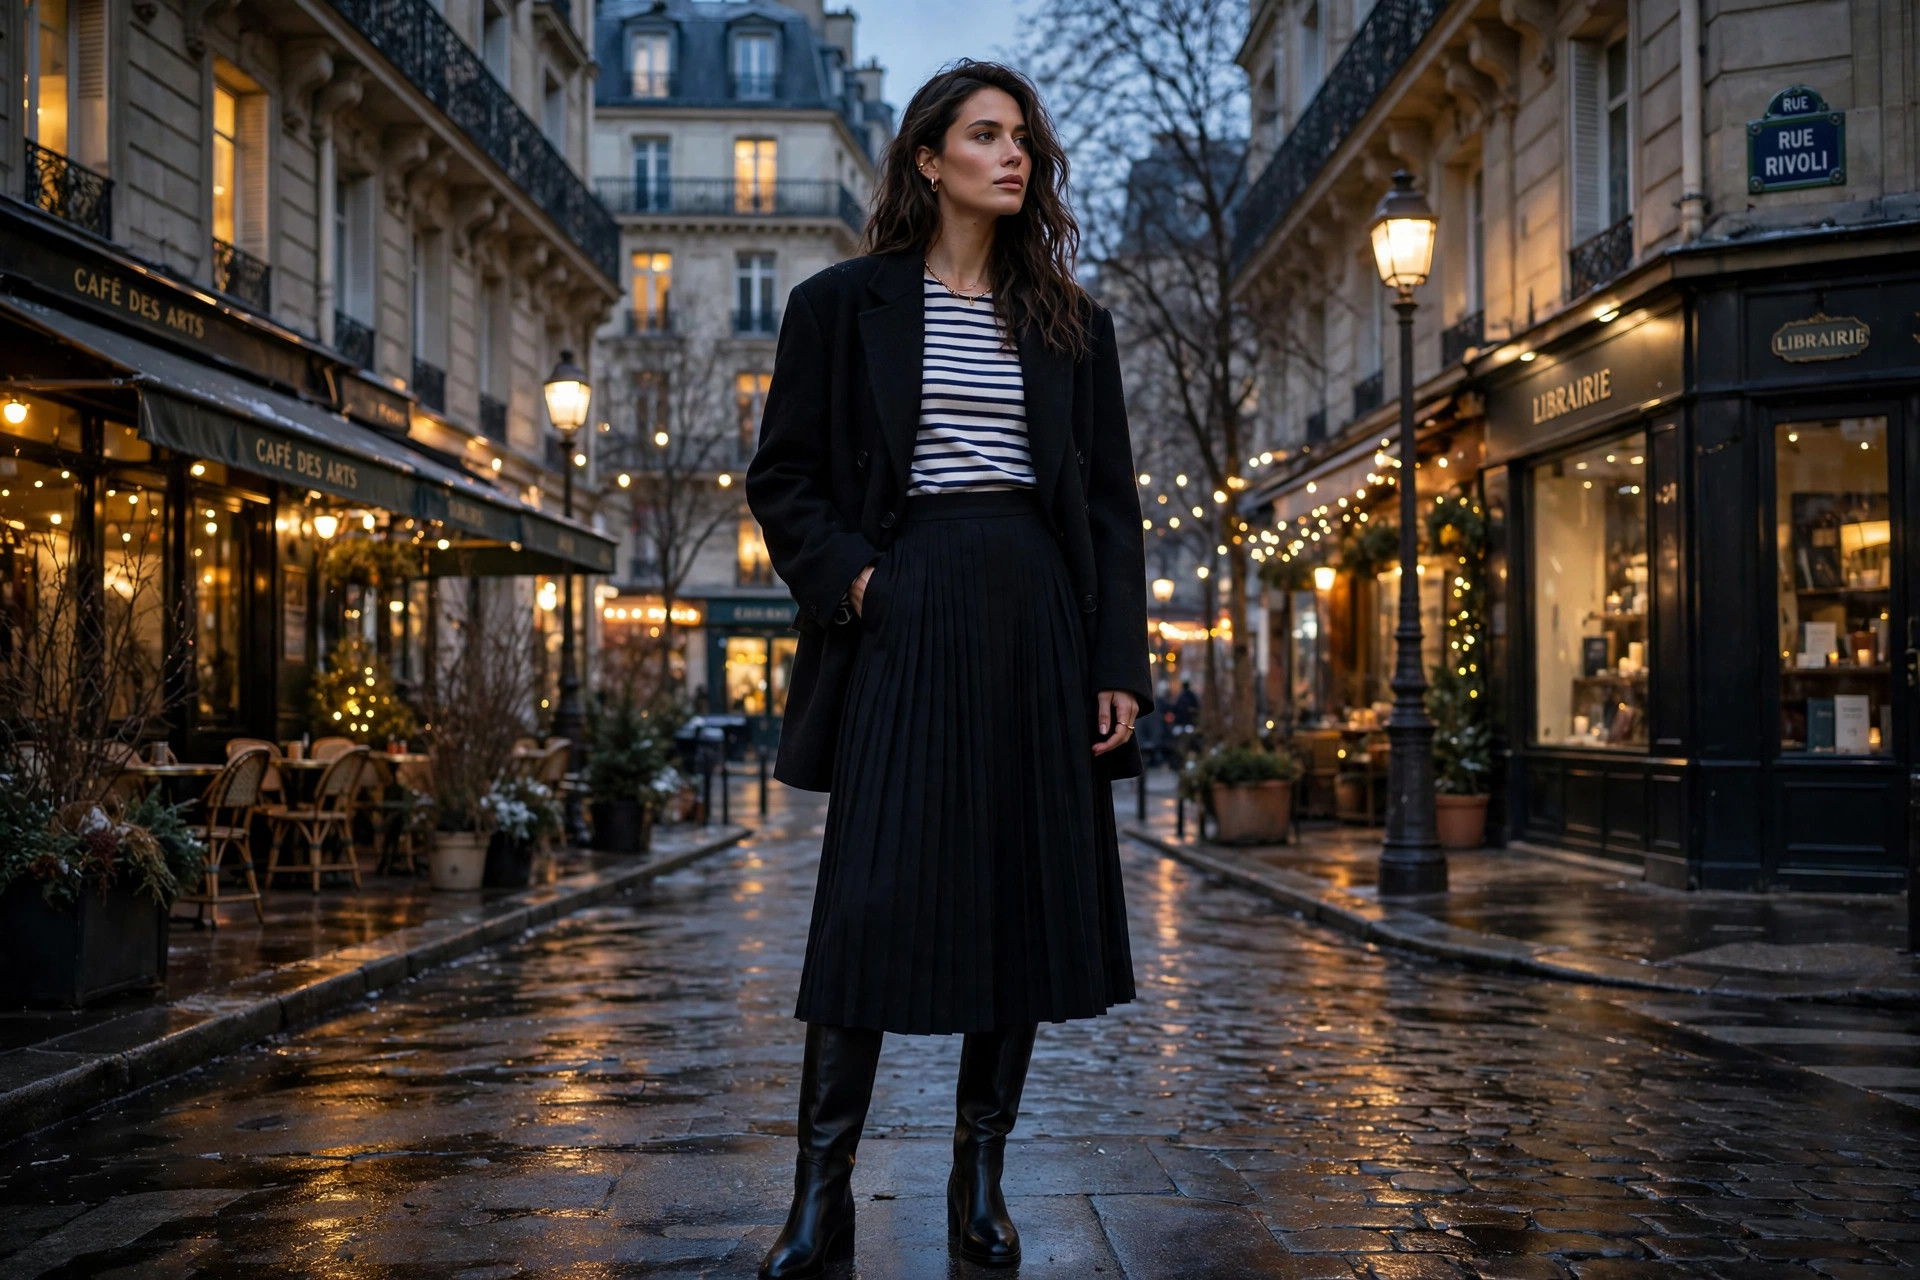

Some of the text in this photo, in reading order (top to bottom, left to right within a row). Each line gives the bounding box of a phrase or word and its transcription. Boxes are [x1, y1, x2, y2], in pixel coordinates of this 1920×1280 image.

[1782, 96, 1809, 112] RUE
[1778, 128, 1815, 150] RUE
[1765, 150, 1828, 176] RIVOLI
[74, 267, 205, 339] CAFÉ DES ARTS
[1777, 328, 1866, 351] LIBRAIRIE
[1533, 368, 1611, 425] LIBRAIRIE
[256, 438, 358, 489] CAFÉ DES ARTS
